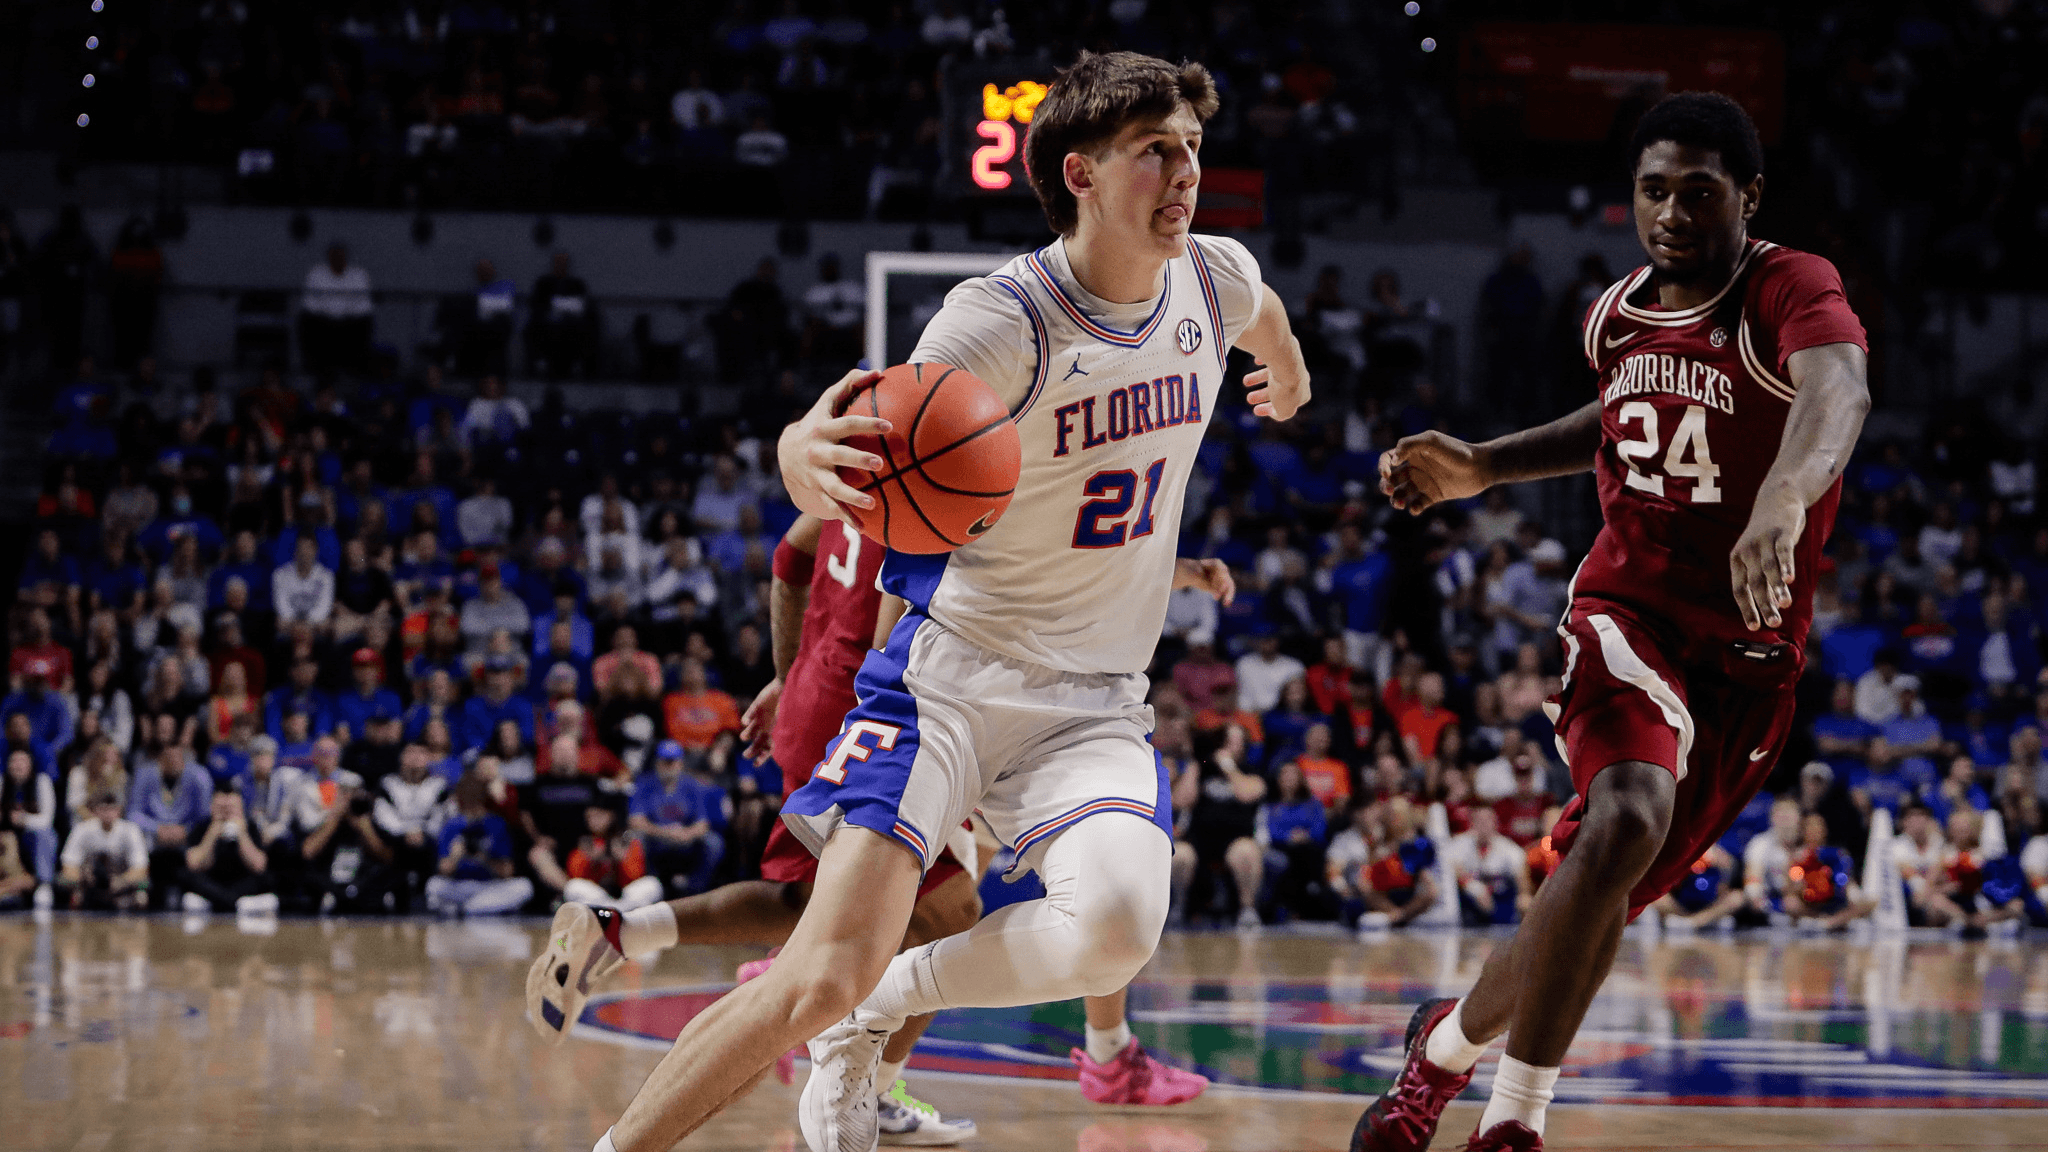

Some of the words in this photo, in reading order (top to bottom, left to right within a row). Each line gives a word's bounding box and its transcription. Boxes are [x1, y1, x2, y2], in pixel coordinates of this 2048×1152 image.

[971, 120, 1029, 189] 2
[1178, 319, 1202, 354] SEC
[1053, 372, 1202, 458] FLORIDA
[1604, 353, 1734, 415] RAZORBACKS
[1617, 401, 1722, 503] 24
[1071, 457, 1167, 549] 21
[814, 719, 902, 786] F
